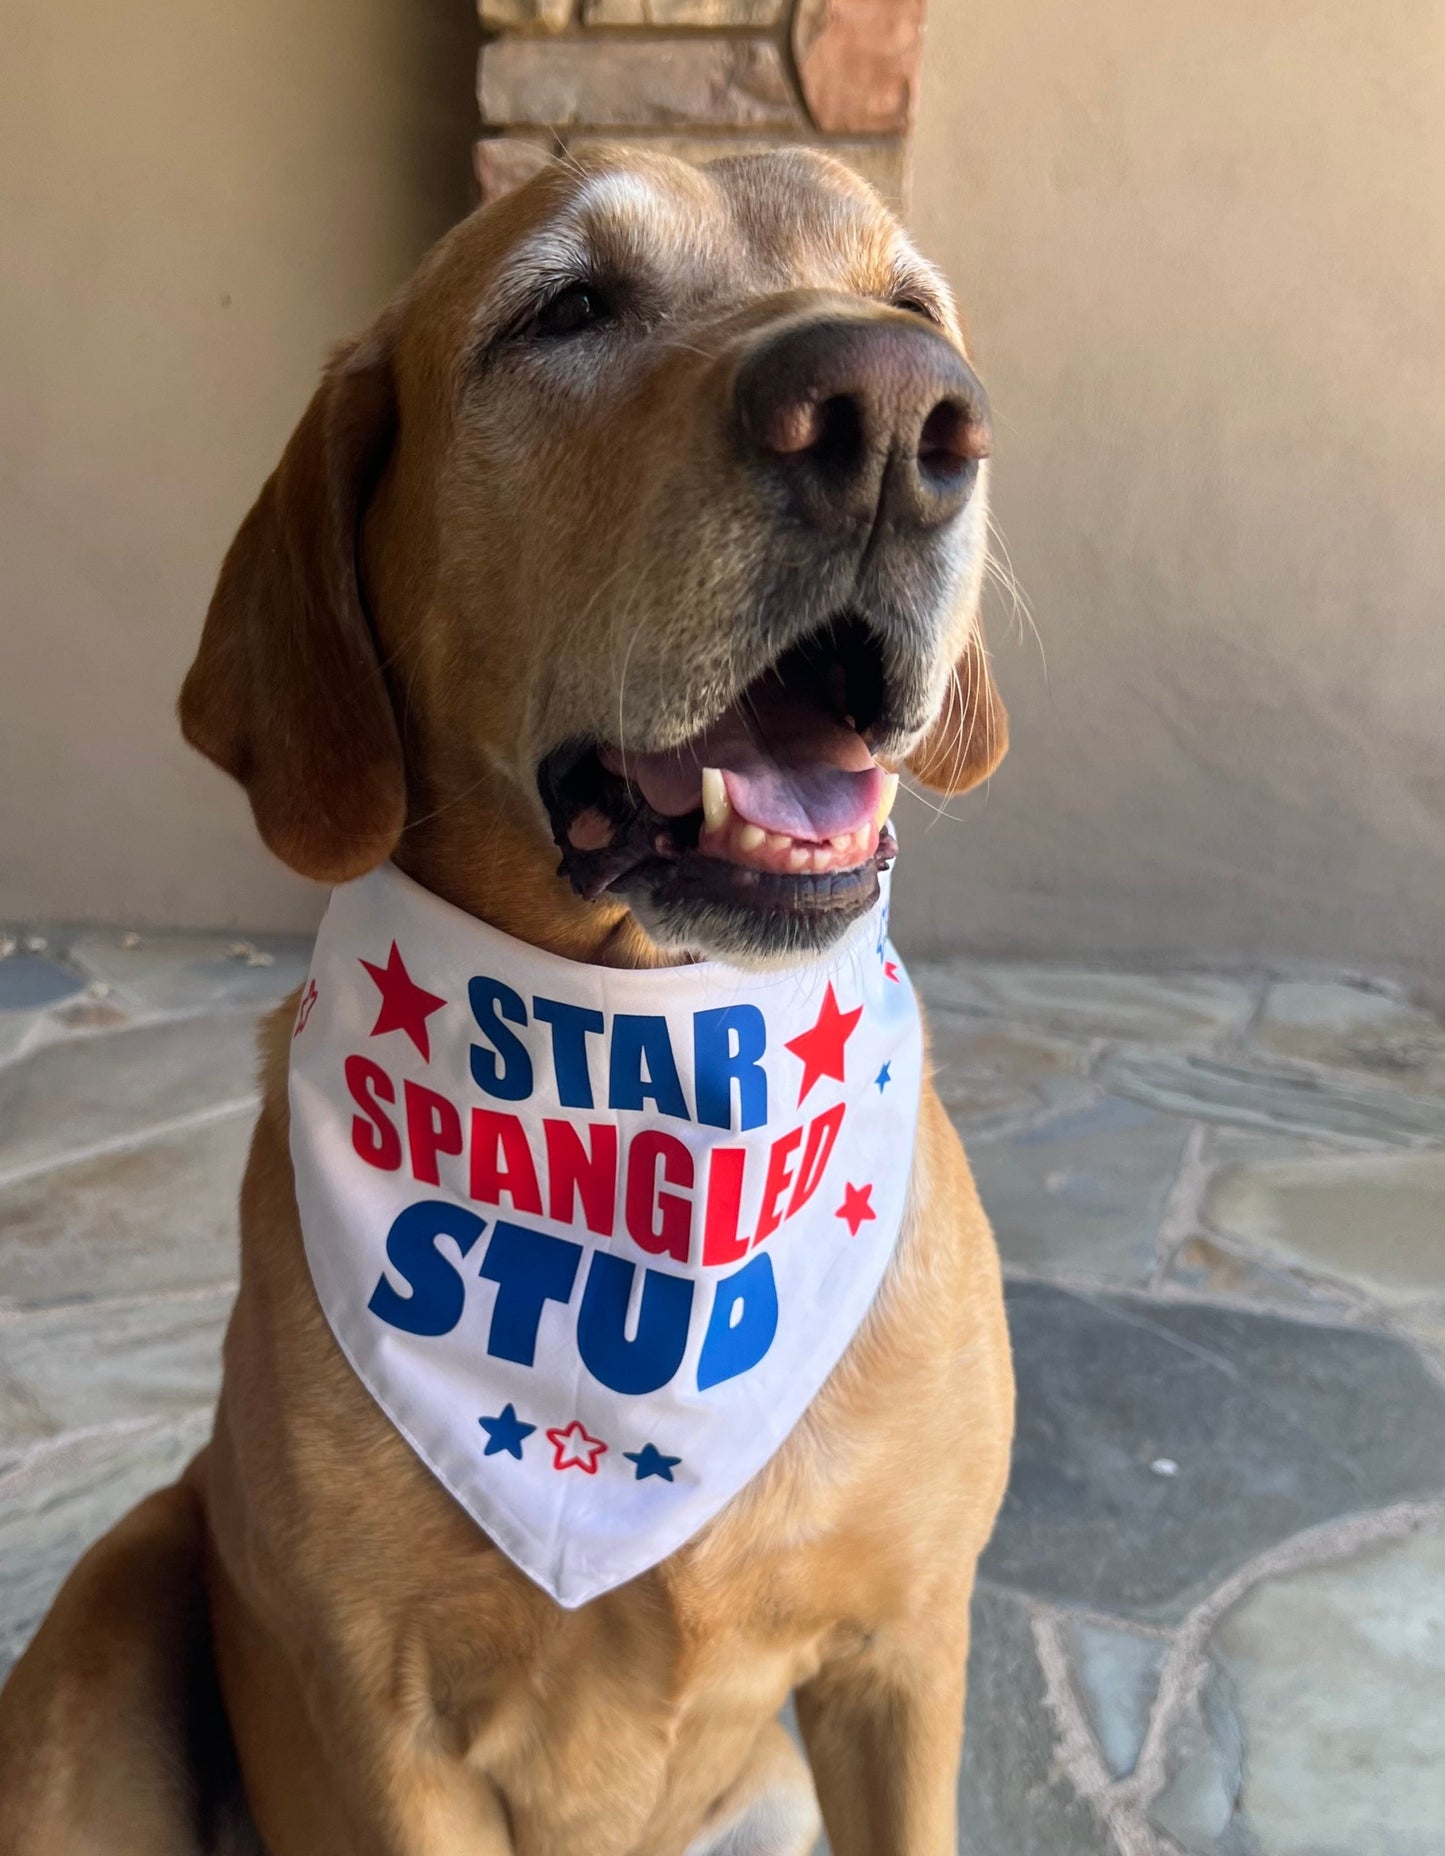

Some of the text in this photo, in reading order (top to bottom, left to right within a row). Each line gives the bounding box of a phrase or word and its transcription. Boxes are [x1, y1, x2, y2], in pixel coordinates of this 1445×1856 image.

[469, 976, 769, 1133] STAR
[344, 1055, 846, 1268] SPANGLED
[368, 1200, 781, 1396] STUD
